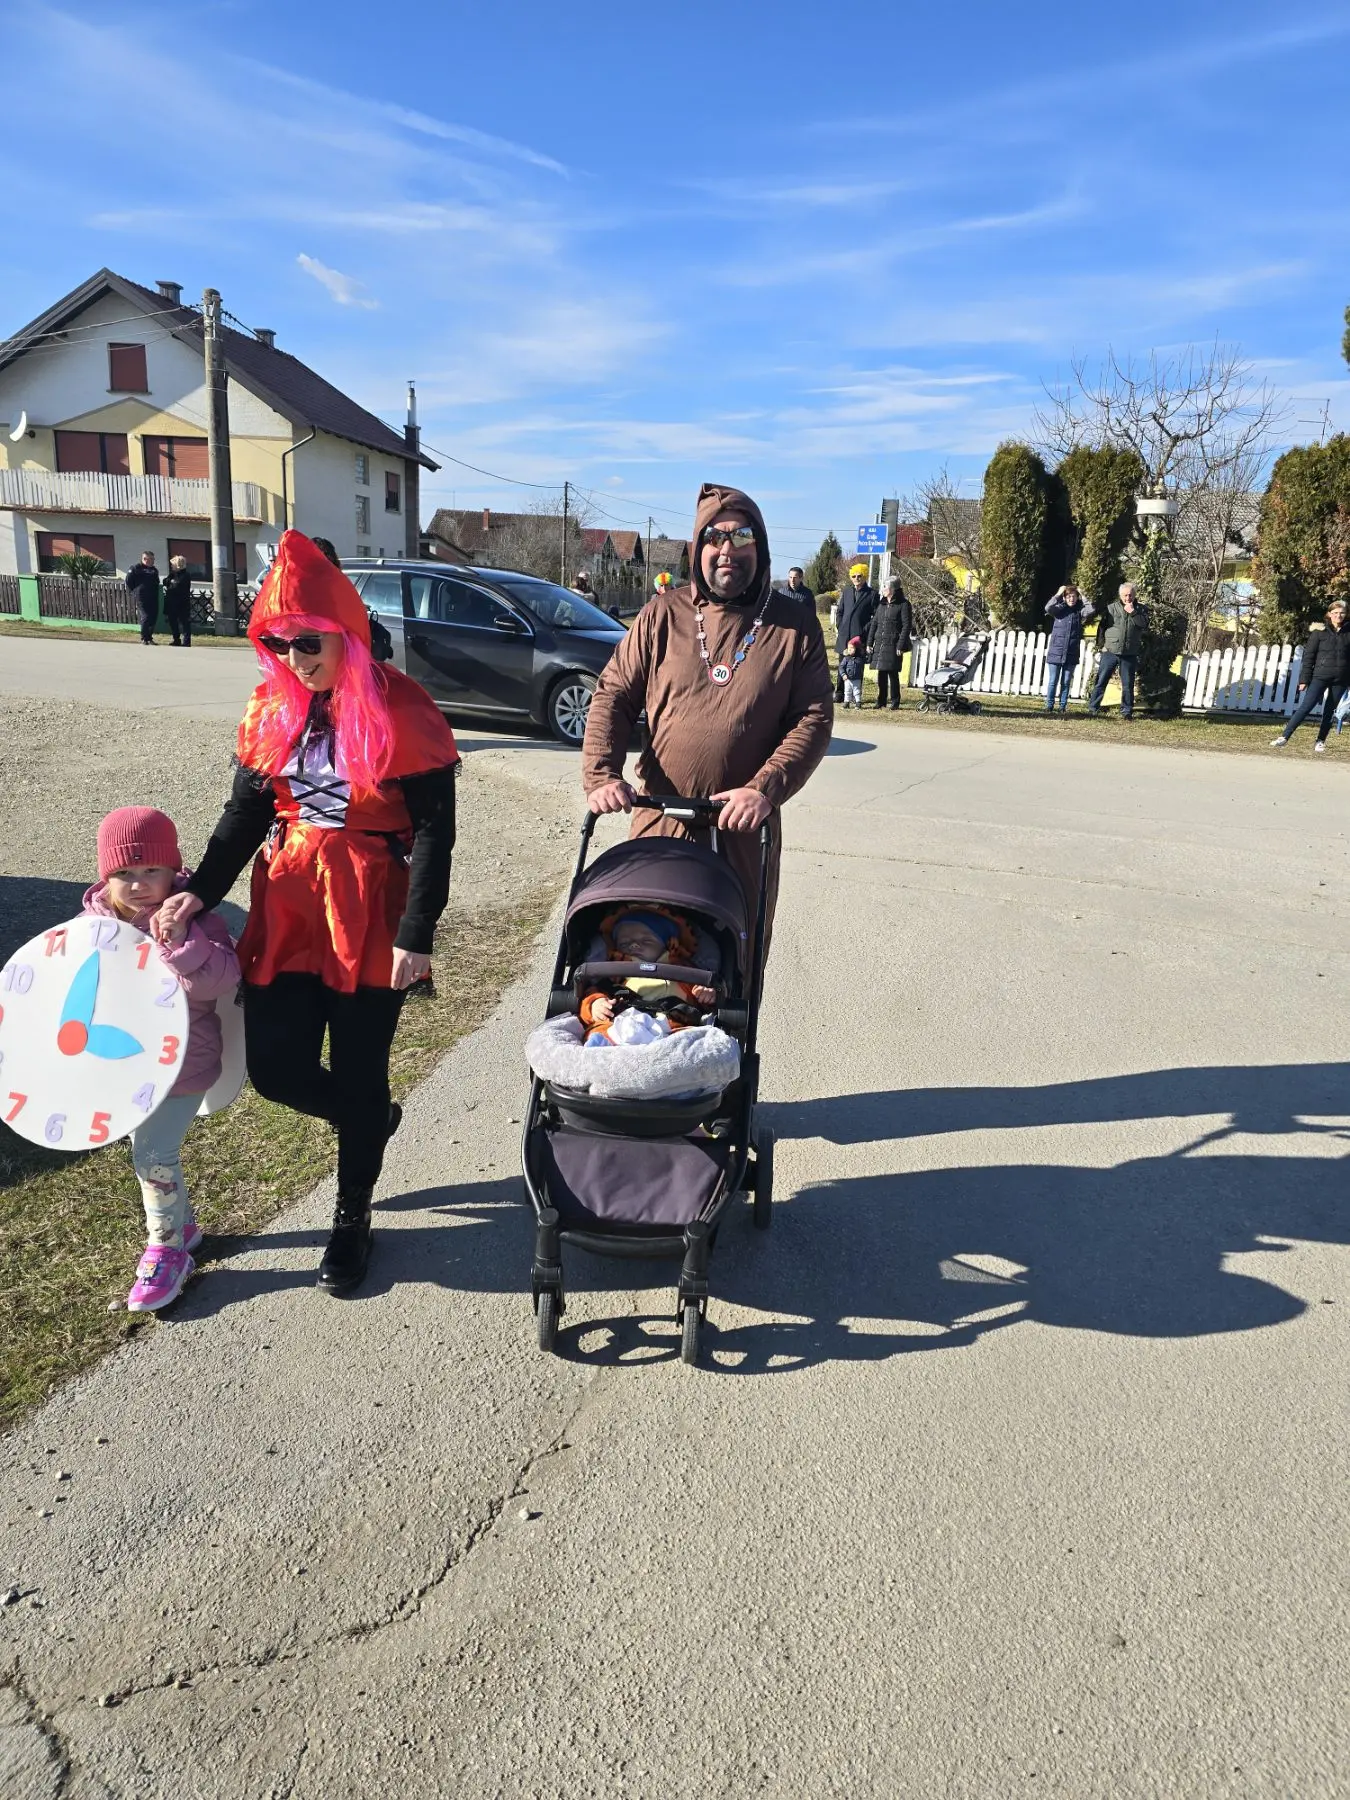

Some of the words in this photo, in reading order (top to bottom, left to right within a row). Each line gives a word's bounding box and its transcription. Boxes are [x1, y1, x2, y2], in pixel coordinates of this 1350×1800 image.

[714, 668, 727, 679] 30
[44, 927, 69, 957] 11
[90, 920, 119, 951] 12
[135, 943, 152, 970] 1
[4, 962, 34, 995] 10
[155, 978, 179, 1008] 2
[159, 1036, 180, 1065] 3
[4, 1091, 28, 1123] 7
[132, 1083, 156, 1113] 4
[44, 1113, 67, 1143] 6
[88, 1111, 112, 1143] 5
